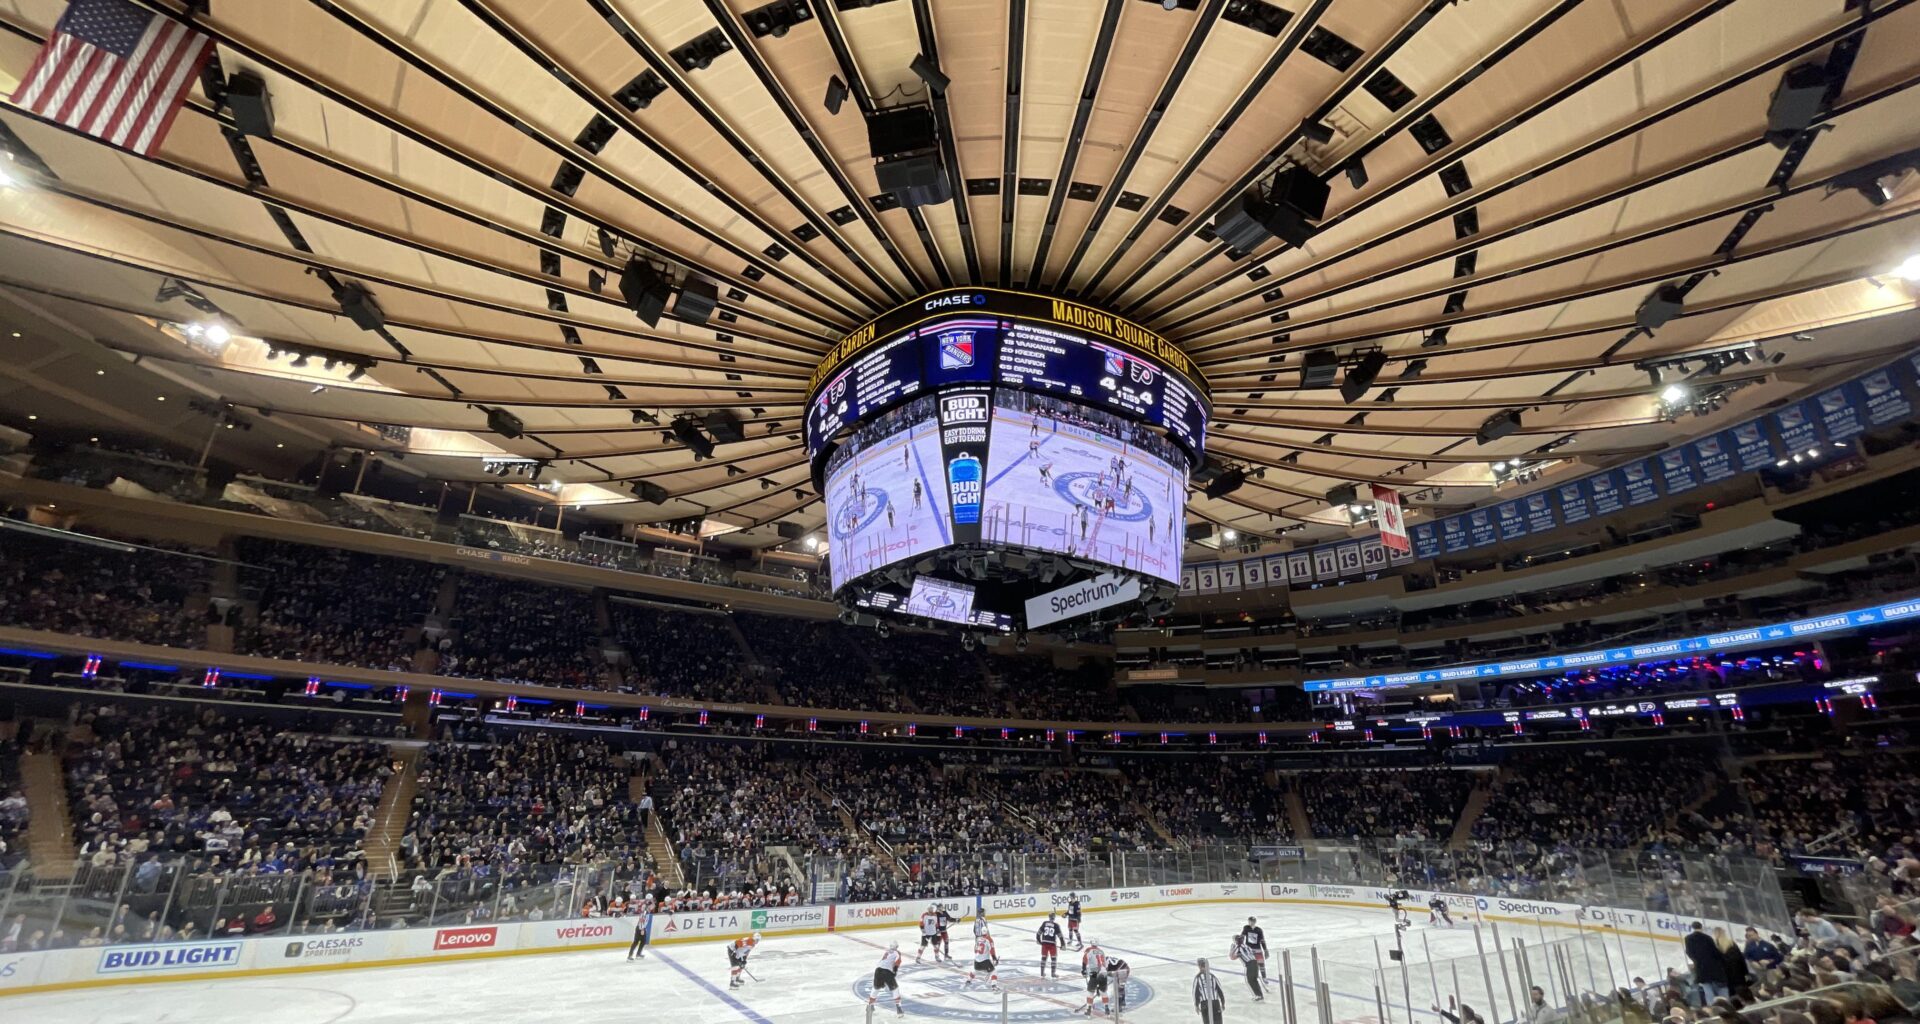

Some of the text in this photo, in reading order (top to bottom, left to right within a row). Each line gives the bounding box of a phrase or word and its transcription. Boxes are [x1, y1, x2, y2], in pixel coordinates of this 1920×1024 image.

[925, 295, 970, 310] CHASE
[841, 323, 876, 358] GARDEN
[1052, 300, 1189, 374] MADISON SQUARE GARDEN
[1053, 330, 1088, 344] RANGERS
[946, 345, 972, 364] RANGERS
[1100, 377, 1116, 390] 4
[948, 398, 980, 410] BUD
[1140, 392, 1153, 406] 4
[942, 408, 986, 422] LIGHT
[944, 428, 958, 438] EASY
[967, 427, 986, 436] DRINK
[944, 435, 958, 445] EASY
[967, 434, 986, 442] ENJOY
[952, 481, 979, 494] BUD
[456, 548, 530, 565] CHASE BRIDGE
[1342, 552, 1358, 568] 19
[1364, 548, 1384, 564] 30
[1272, 566, 1281, 578] 9
[1294, 562, 1307, 576] 11
[1320, 558, 1333, 573] 11
[1204, 575, 1212, 588] 3
[1226, 572, 1234, 586] 7
[1250, 569, 1258, 582] 9
[1182, 576, 1190, 590] 2
[1050, 582, 1115, 615] Spectrum
[1884, 608, 1908, 617] BUD
[1793, 617, 1846, 632] BUD LIGHT
[1730, 632, 1759, 642] LIGHT
[1653, 644, 1678, 654] LIGHT
[1581, 654, 1604, 662] LIGHT
[1842, 684, 1866, 694] 13
[1120, 890, 1140, 900] PEPSI
[994, 898, 1026, 909] CHASE
[1498, 900, 1556, 915] Spectrum
[756, 911, 822, 925] enterprise
[864, 906, 900, 917] DUNKIN'
[682, 916, 738, 930] DELTA
[556, 924, 613, 939] verizon
[306, 938, 364, 950] CAESARS
[439, 932, 492, 946] Lenovo
[104, 946, 236, 968] BUD LIGHT
